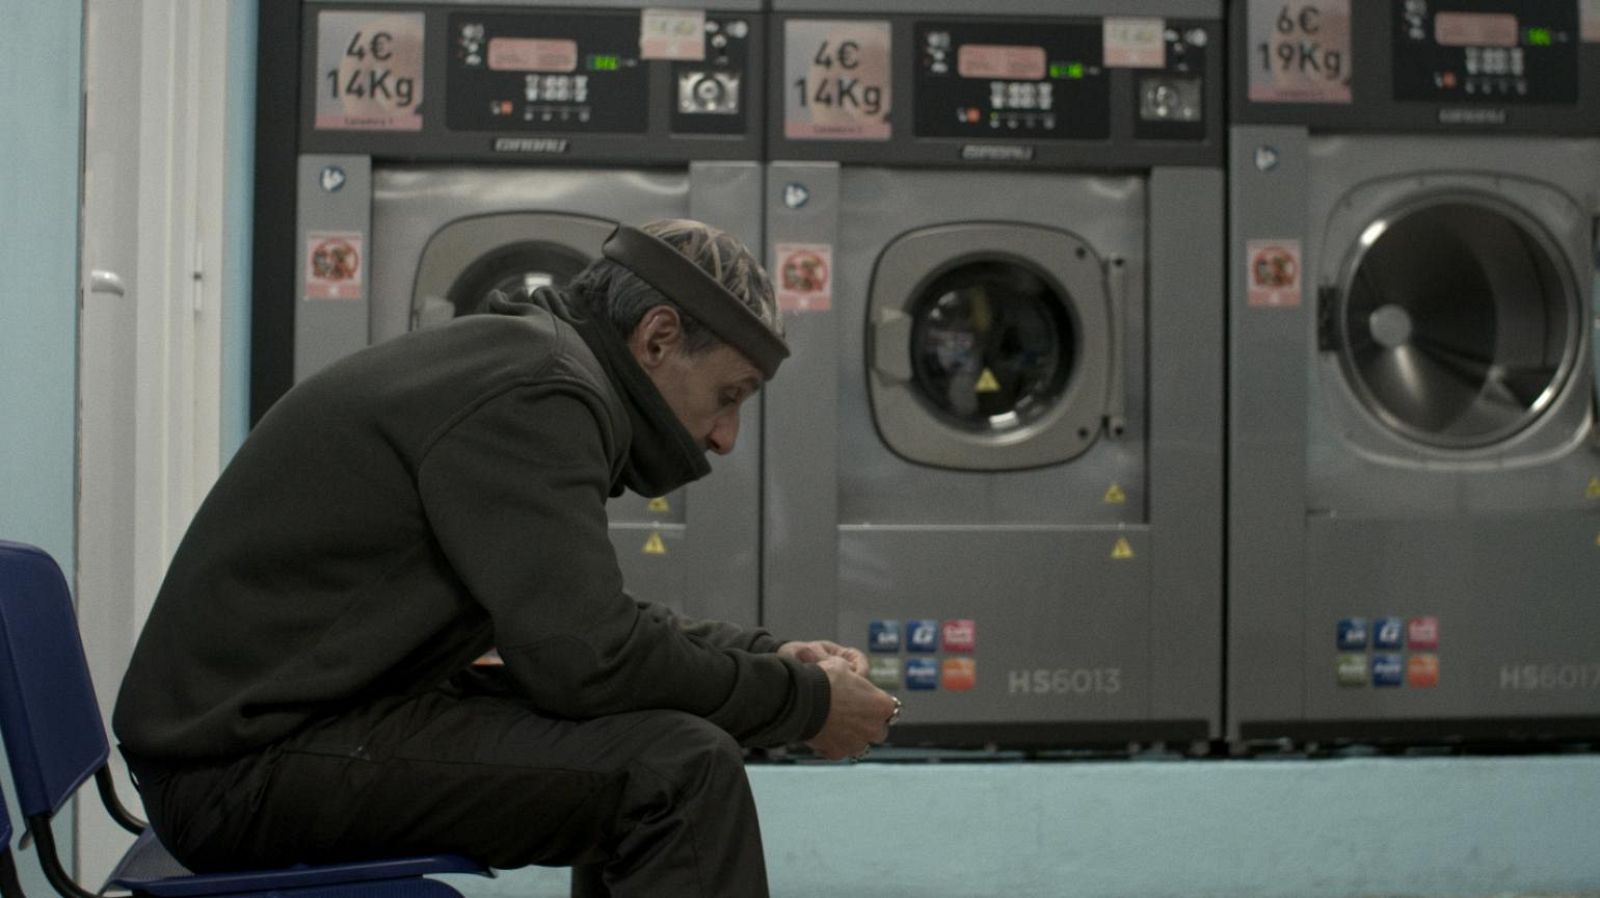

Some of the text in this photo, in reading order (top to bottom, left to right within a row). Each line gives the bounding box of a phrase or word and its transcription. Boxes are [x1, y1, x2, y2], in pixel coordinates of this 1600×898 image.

[1277, 6, 1320, 35] 6€
[346, 32, 393, 61] 4€
[814, 41, 860, 70] 4€
[1258, 42, 1341, 80] 19Kg
[327, 69, 414, 108] 14Kg
[794, 78, 882, 115] 14Kg
[1008, 669, 1122, 695] HS6013
